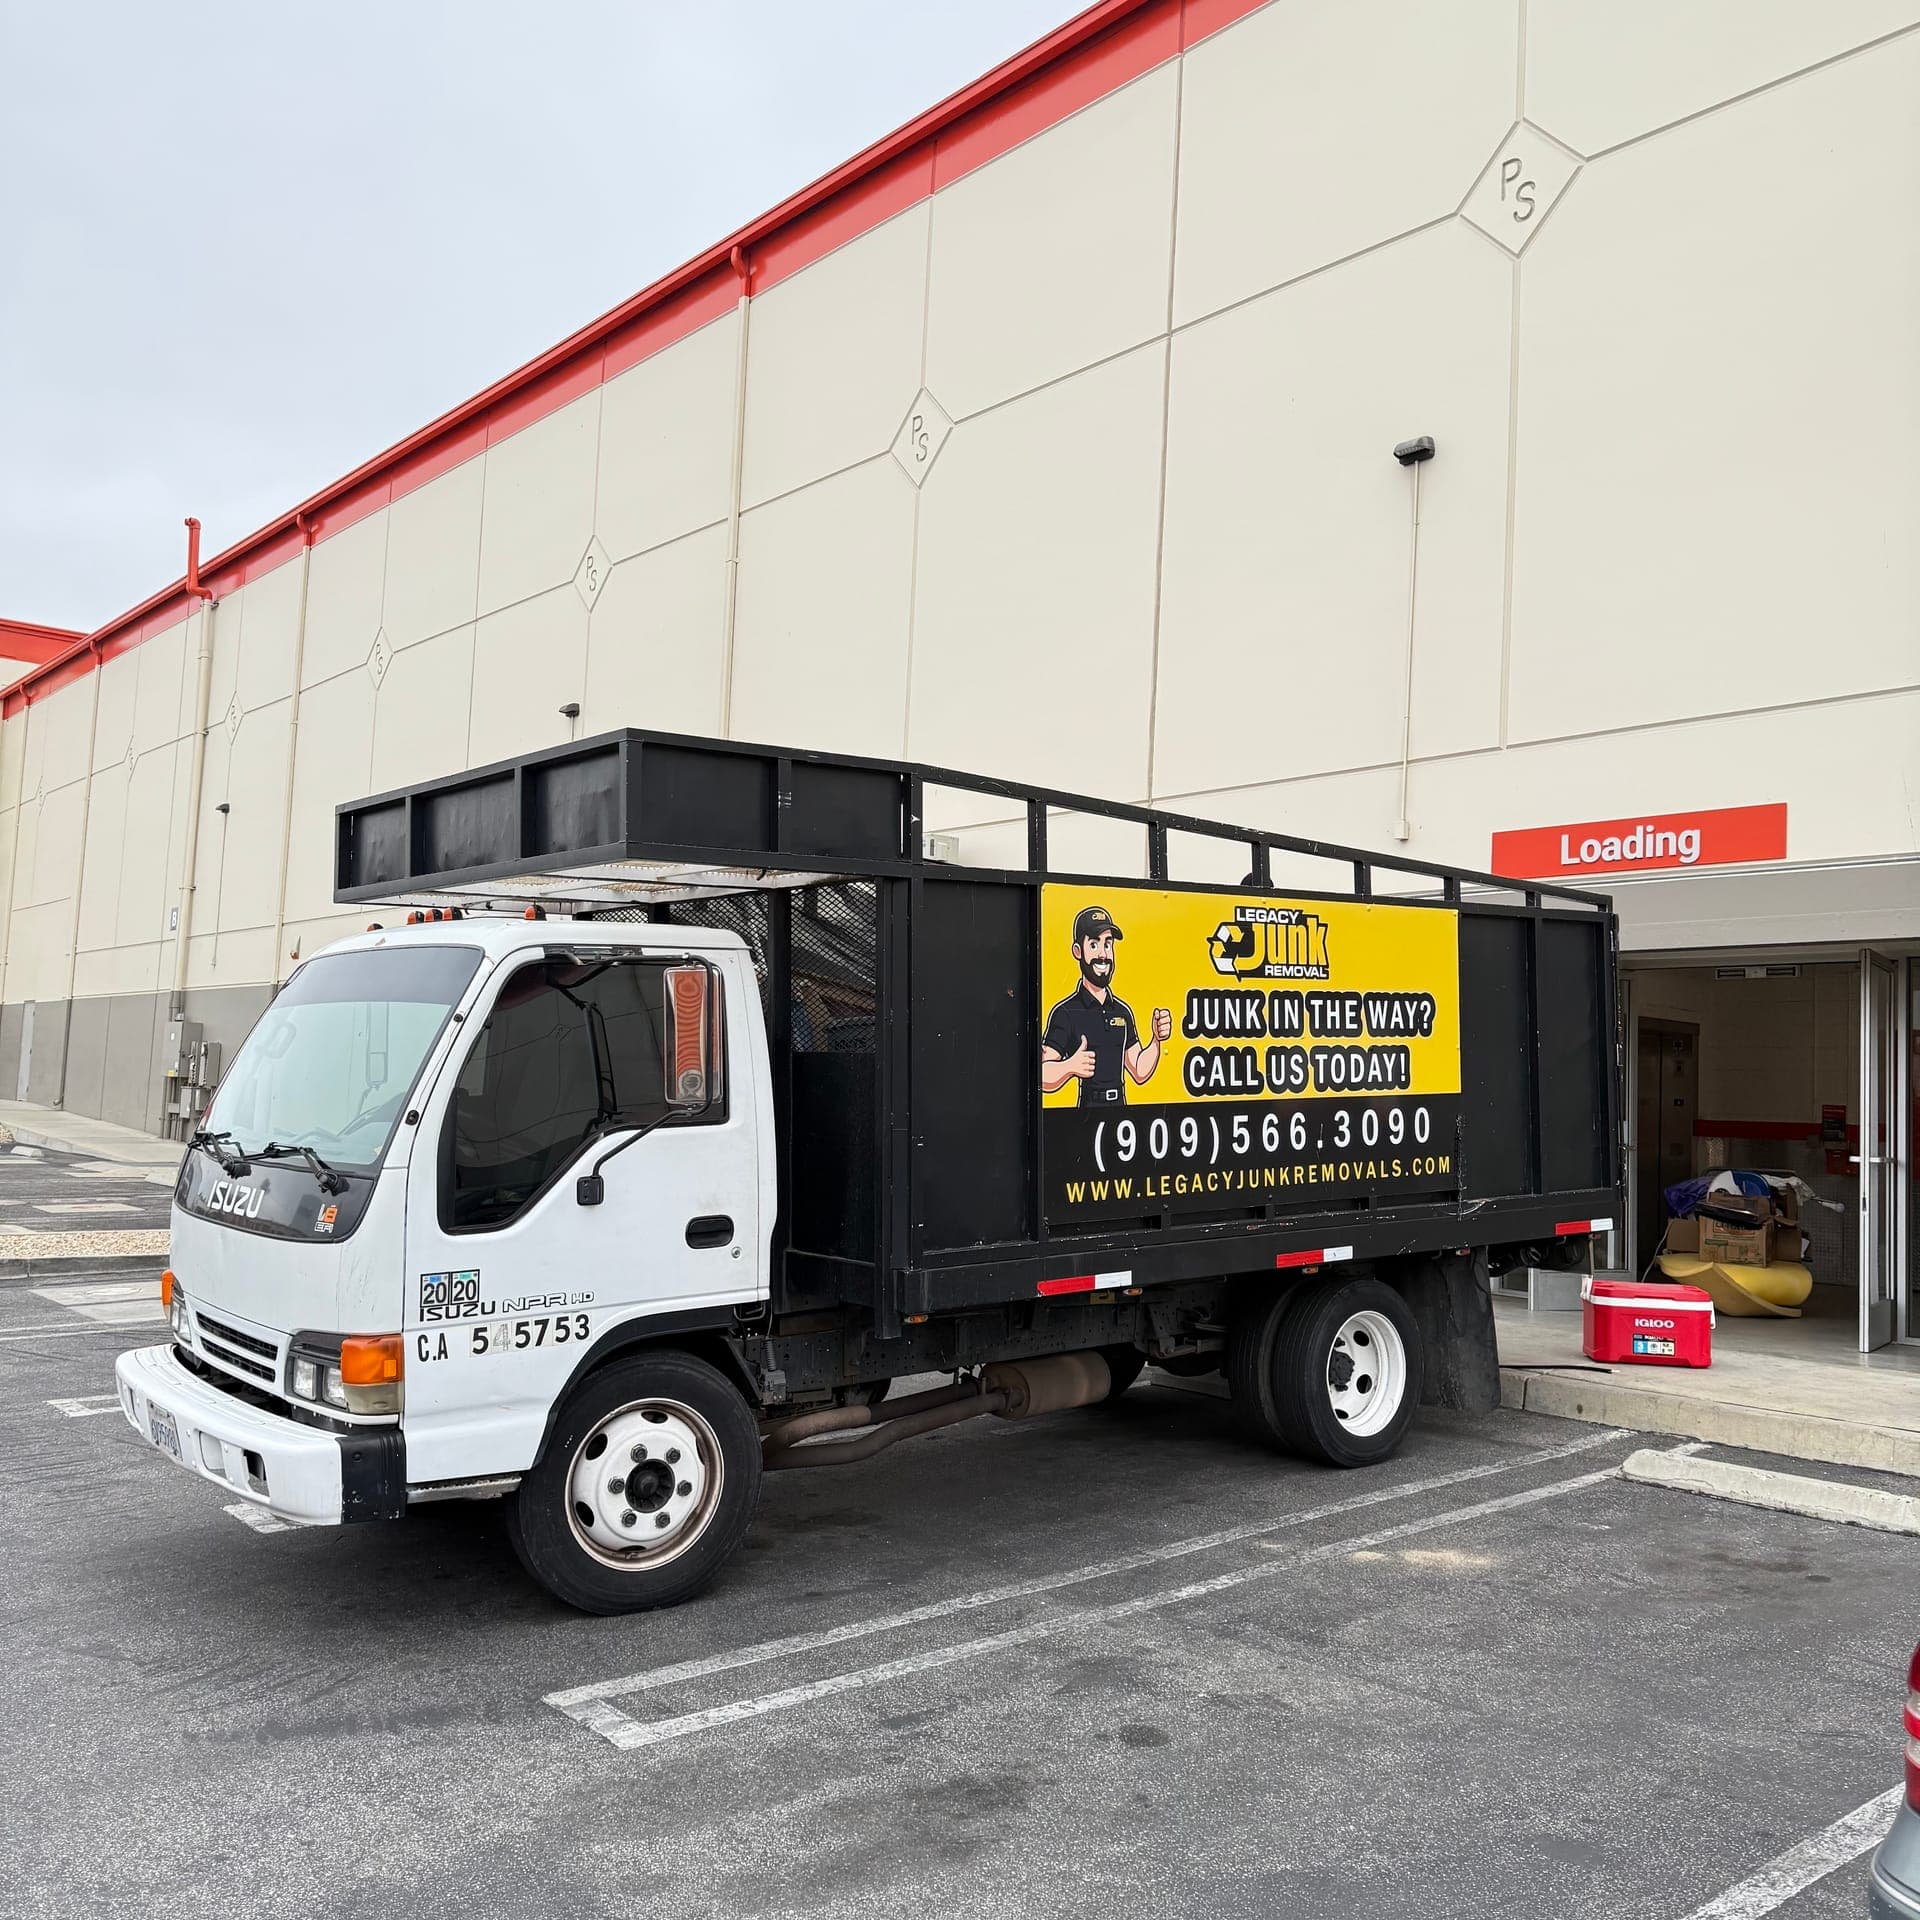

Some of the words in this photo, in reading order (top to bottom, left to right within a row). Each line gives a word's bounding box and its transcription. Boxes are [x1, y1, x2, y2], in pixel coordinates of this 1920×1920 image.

[1501, 158, 1536, 223] PS
[911, 415, 929, 463] PS
[1560, 825, 1701, 864] Loading
[1236, 907, 1300, 924] LEGACY
[1233, 917, 1327, 971] Junk
[1264, 965, 1328, 977] REMOVAL
[1188, 998, 1262, 1030] JUNK
[1273, 998, 1299, 1030] IN
[1310, 999, 1358, 1030] THE
[1368, 1000, 1432, 1030] WAY?
[1189, 1055, 1259, 1088] CALL
[1271, 1053, 1304, 1086] US
[1314, 1053, 1407, 1084] TODAY!
[1093, 1107, 1431, 1172] (909)566.3090
[1066, 1155, 1451, 1203] WWW.LEGACYJUNKREMOVALS.COM
[207, 1180, 265, 1219] ISUZU
[419, 1300, 496, 1322] ISUZU
[502, 1291, 567, 1313] NPR
[571, 1291, 594, 1304] HD
[1634, 1318, 1675, 1329] IGLOO
